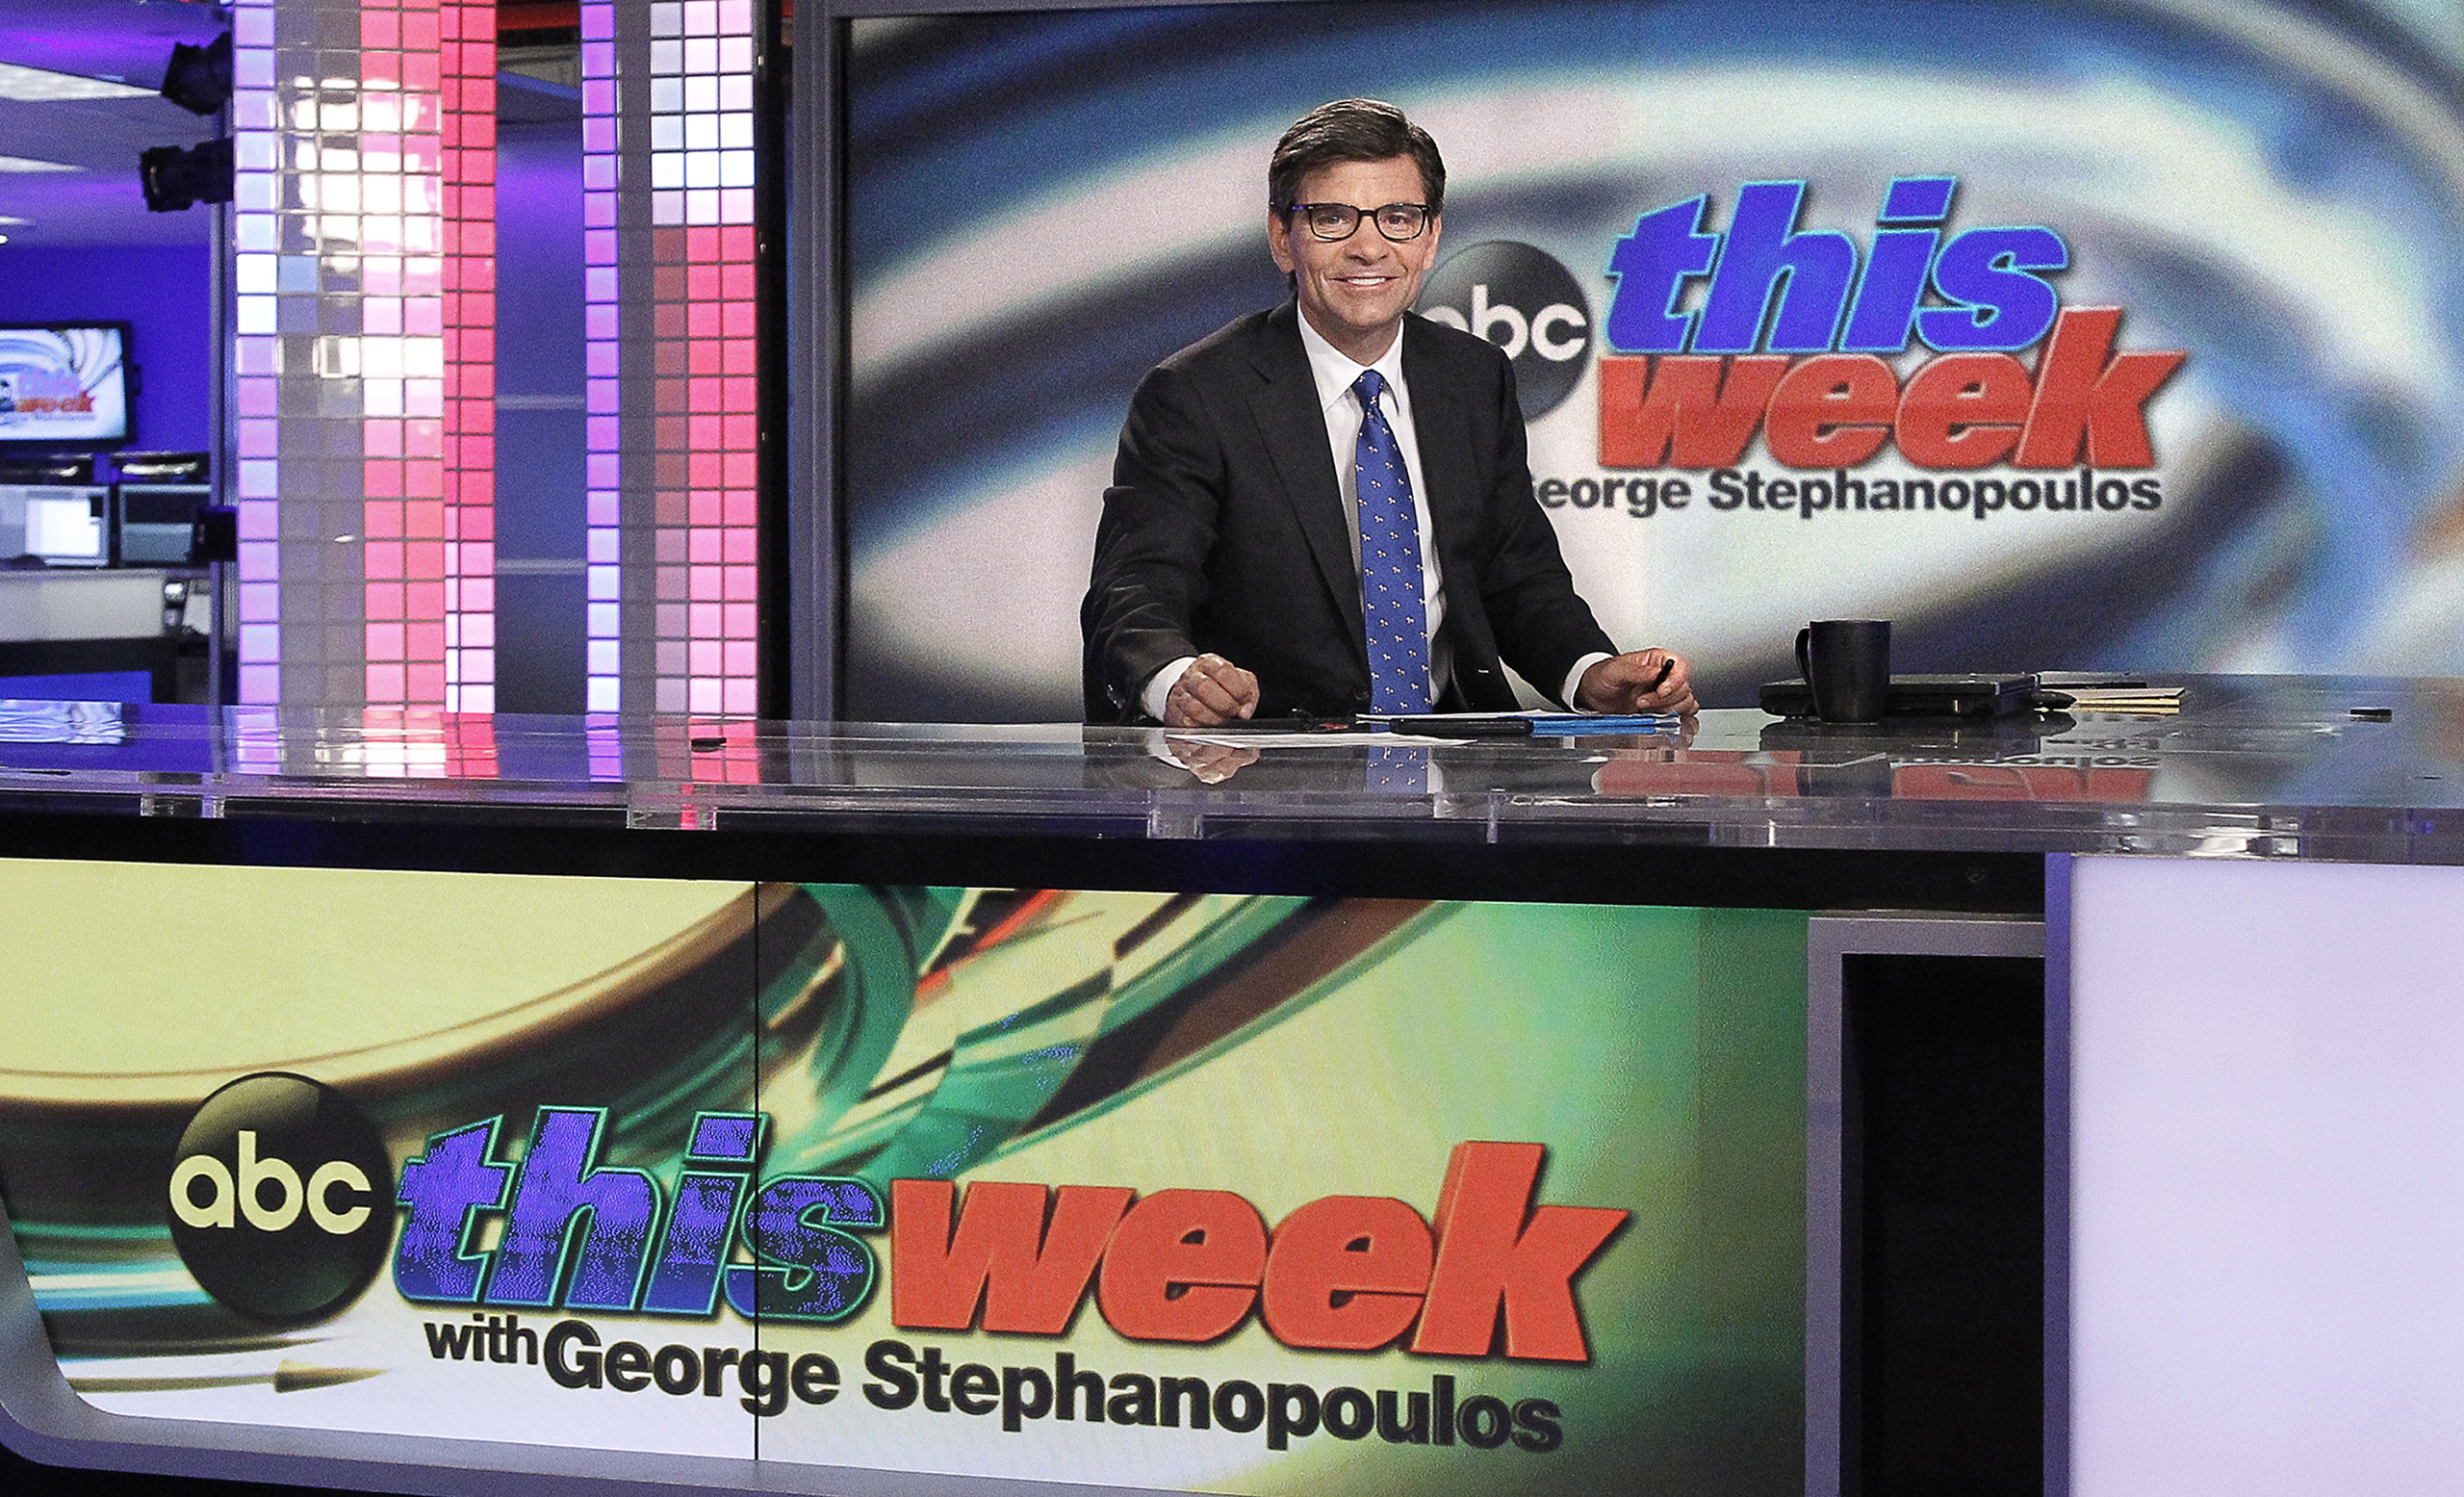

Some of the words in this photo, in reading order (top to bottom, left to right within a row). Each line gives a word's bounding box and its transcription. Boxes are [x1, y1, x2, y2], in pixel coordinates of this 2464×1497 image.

[1604, 175, 2070, 353] this
[1598, 307, 2188, 469] week
[1532, 477, 1691, 519] eorge
[1707, 468, 2162, 520] Stephanopoulos
[169, 1130, 372, 1235] abc
[393, 1104, 885, 1322] this
[890, 1140, 1631, 1361] week
[424, 1314, 538, 1366] with
[544, 1319, 840, 1417] George
[862, 1339, 1563, 1451] Stephanopoulos
